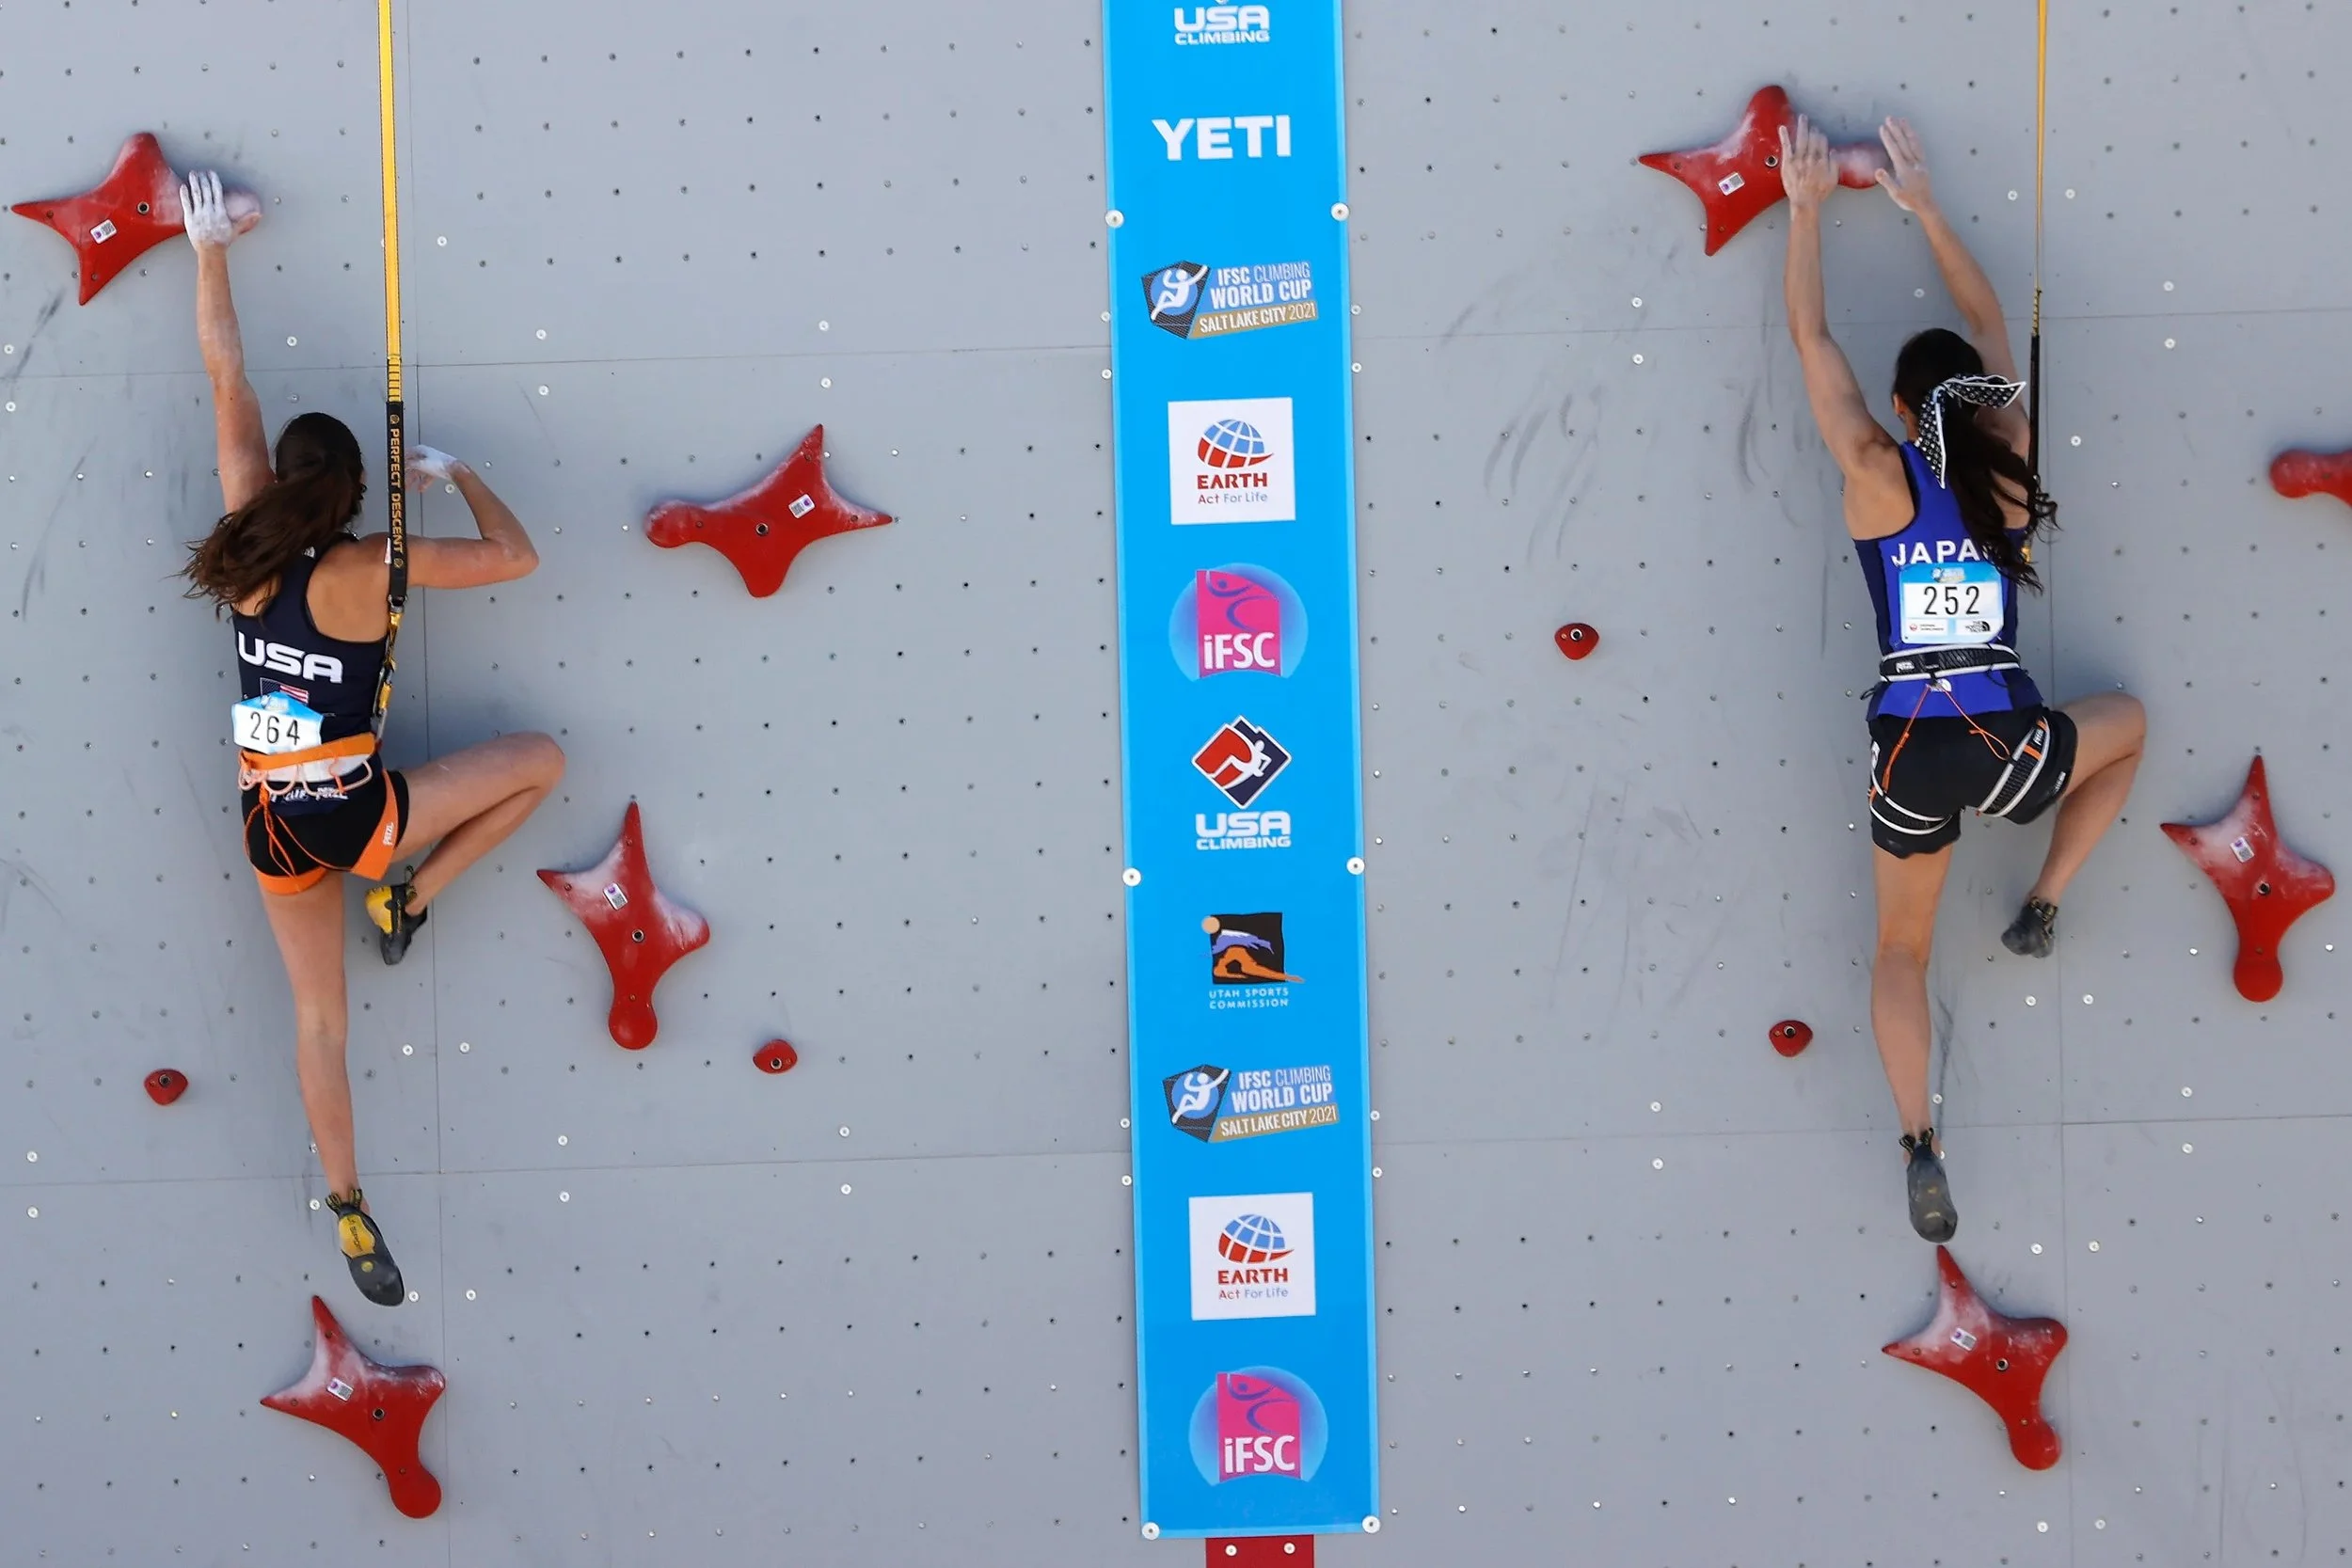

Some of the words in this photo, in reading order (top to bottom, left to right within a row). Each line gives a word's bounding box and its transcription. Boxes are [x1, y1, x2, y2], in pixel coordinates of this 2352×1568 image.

[1174, 5, 1270, 32] USA
[1174, 30, 1270, 45] CLIMBING
[1152, 115, 1292, 161] YETI
[1217, 267, 1250, 286] IFSC
[1253, 262, 1311, 282] CLIMBING
[1210, 283, 1274, 309] WORLD
[1278, 278, 1312, 300] CUP
[1199, 316, 1228, 333] SALT
[1230, 312, 1260, 329] LAKE
[1261, 308, 1287, 326] CITY
[1288, 303, 1316, 321] 2021
[389, 428, 402, 488] PERFECT
[1197, 472, 1268, 490] EARTH
[1198, 494, 1220, 504] Act
[1223, 493, 1243, 503] For
[1245, 491, 1268, 502] Life
[390, 493, 405, 553] DESCENT
[1890, 538, 1991, 567] JAPA
[1923, 585, 1980, 615] 252
[238, 630, 343, 685] USA
[1203, 632, 1276, 670] iFSC
[250, 711, 301, 746] 264
[1195, 811, 1292, 838] USA
[1196, 835, 1293, 851] CLIMBING
[1209, 990, 1240, 999] UTAH
[1245, 987, 1289, 997] SPORTS
[1209, 998, 1289, 1009] COMMISSION
[1238, 1070, 1271, 1090] IFSC
[1275, 1066, 1331, 1086] CLIMBING
[1232, 1086, 1295, 1113] WORLD
[1300, 1083, 1333, 1104] CUP
[1220, 1119, 1249, 1136] SALT
[1251, 1115, 1281, 1132] LAKE
[1281, 1110, 1308, 1128] CITY
[1311, 1104, 1337, 1123] 2021
[1217, 1268, 1288, 1285] EARTH
[1218, 1290, 1241, 1300] Act
[1244, 1289, 1263, 1299] For
[1266, 1287, 1289, 1298] Life
[1224, 1434, 1295, 1474] iFSC
